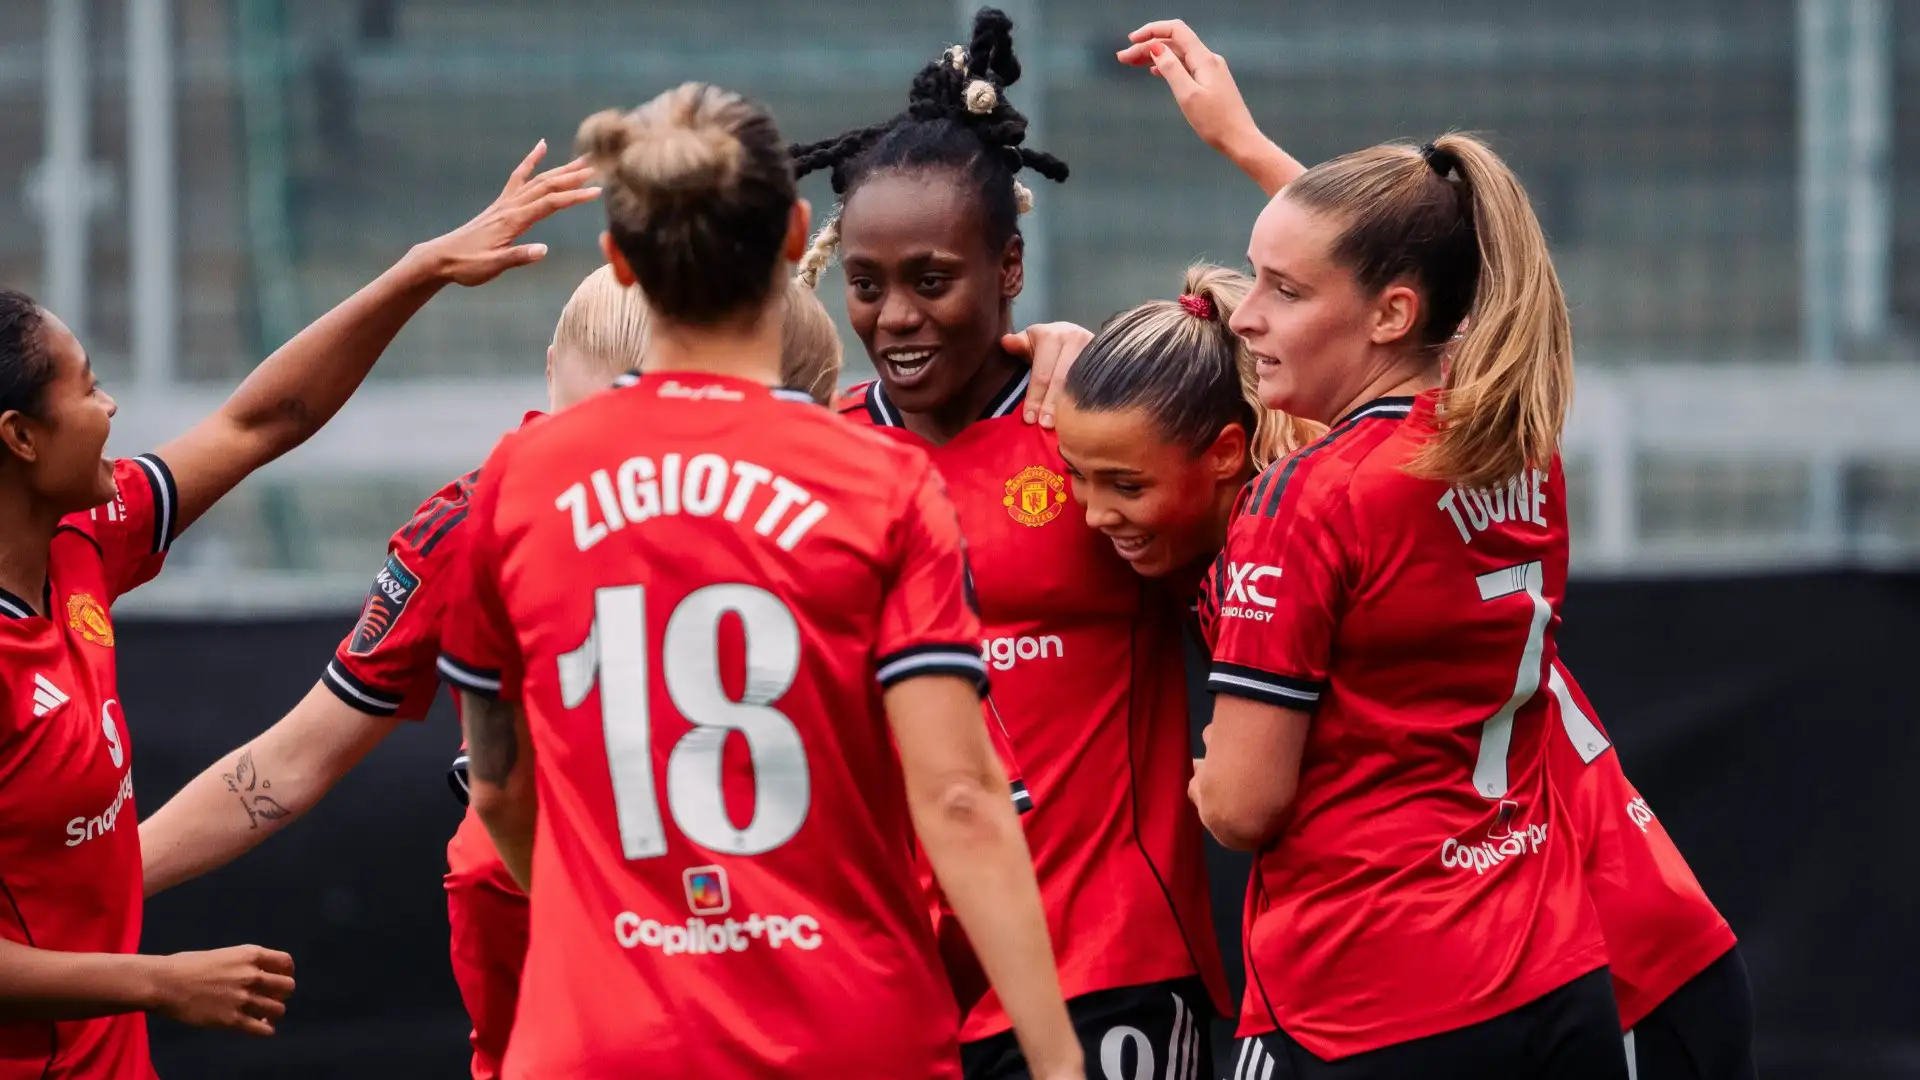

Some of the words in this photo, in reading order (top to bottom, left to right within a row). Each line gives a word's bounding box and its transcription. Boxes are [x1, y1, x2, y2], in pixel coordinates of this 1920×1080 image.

[556, 453, 829, 551] ZIGIOTTI
[1017, 511, 1054, 523] UNITED
[376, 566, 407, 605] WSL
[1226, 561, 1283, 608] XC
[1472, 560, 1552, 799] 7
[557, 583, 811, 860] 18
